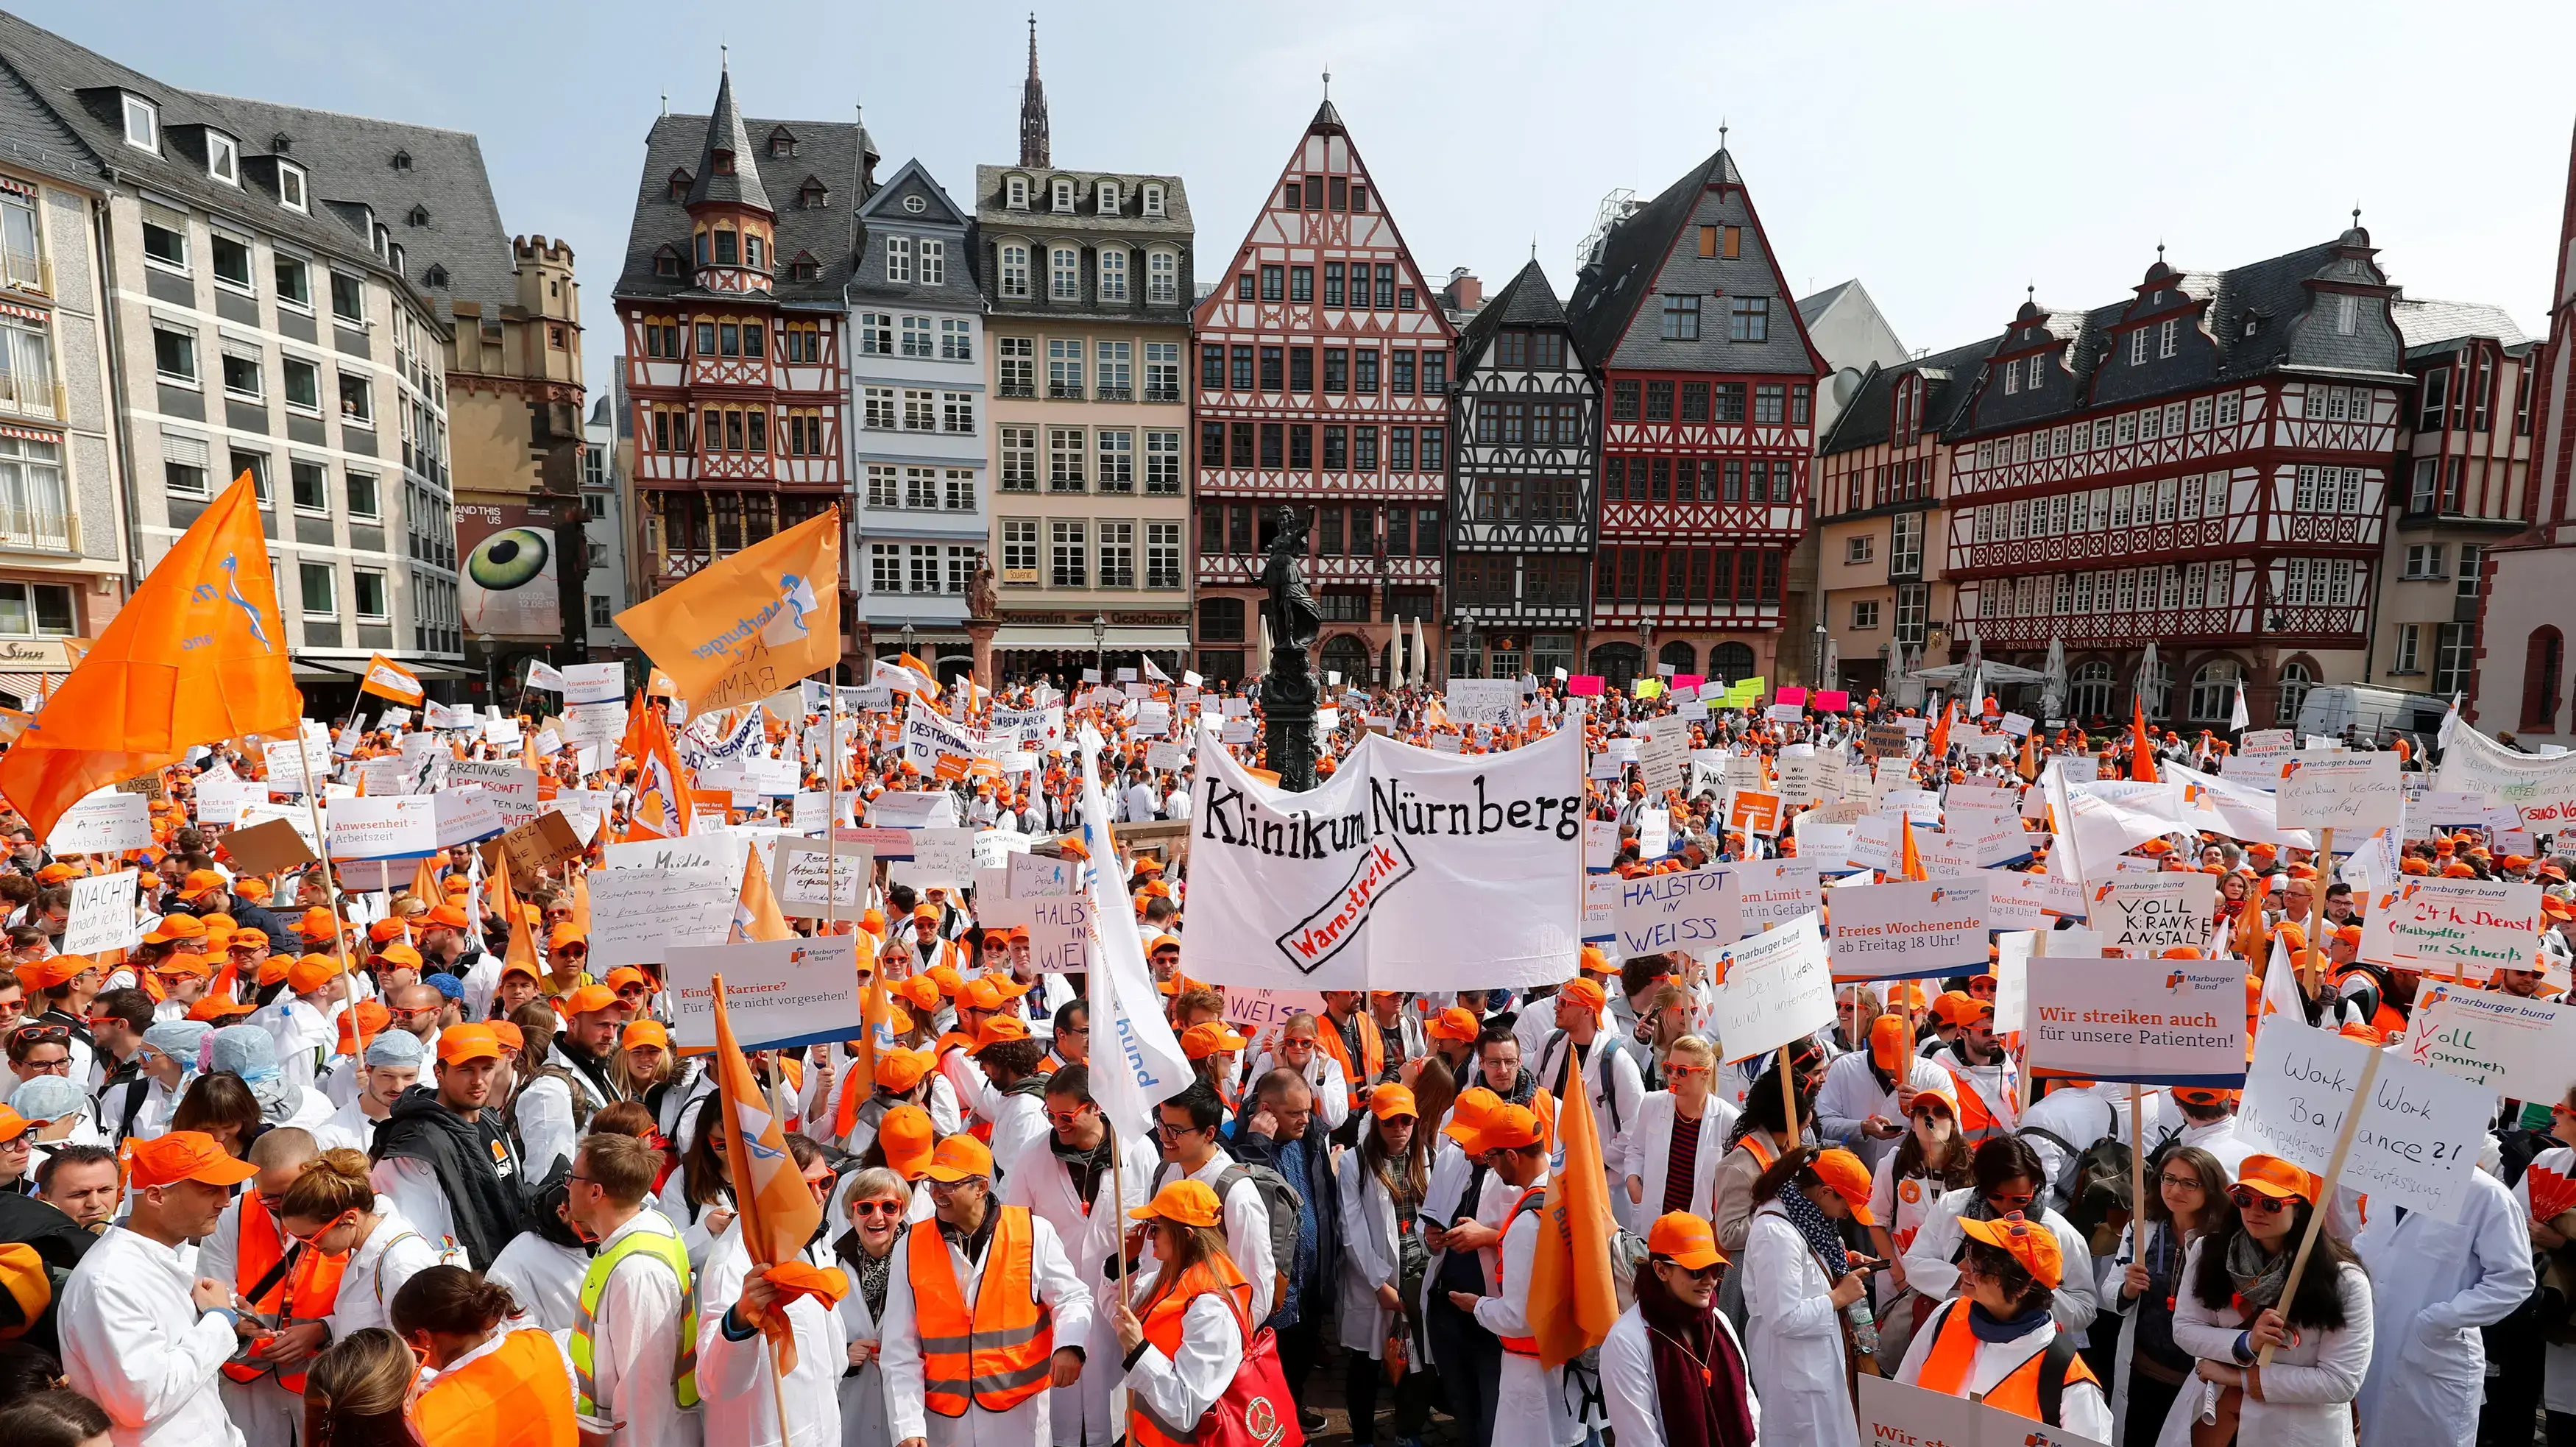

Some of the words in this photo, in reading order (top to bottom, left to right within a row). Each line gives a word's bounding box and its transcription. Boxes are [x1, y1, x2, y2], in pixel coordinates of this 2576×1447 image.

[454, 506, 476, 514] AND
[478, 506, 500, 515] THIS
[487, 516, 501, 524] US
[1002, 612, 1066, 623] Souvenirs
[1111, 612, 1182, 625] Geschenke
[0, 643, 45, 659] Sinn
[567, 679, 609, 687] Anwesenheit
[1457, 693, 1472, 703] WIR
[1476, 693, 1512, 704] LASSEN
[1458, 707, 1479, 719] NICHT
[1022, 715, 1046, 726] ABER
[1869, 737, 1888, 746] MEHR
[2454, 737, 2486, 752] WANN
[911, 743, 928, 757] TO
[1876, 748, 1894, 757] VKA
[2243, 745, 2278, 754] QUALITÄT
[448, 760, 489, 775] ÄRZTIN
[492, 768, 510, 777] AUS
[2501, 768, 2540, 776] STEHT
[127, 777, 160, 791] ARBEITS
[70, 804, 107, 812] marburger
[257, 809, 289, 817] marburger
[516, 802, 533, 811] DAS
[2527, 804, 2558, 820] SIND
[443, 814, 472, 827] streiken
[473, 809, 488, 818] auch
[1202, 776, 1370, 860] Klinikum
[1370, 774, 1582, 842] Nürnberg
[1912, 810, 1936, 818] Gefahr
[334, 818, 408, 832] Anwesenheit
[335, 831, 394, 844] Arbeitszeit
[975, 838, 991, 846] VOM
[974, 848, 990, 857] ZUM
[1933, 854, 1958, 865] Limit
[511, 841, 581, 880] MASCHINE
[590, 874, 612, 885] Wir
[618, 872, 655, 883] streiken
[1622, 871, 1731, 908] HALBTOT
[1945, 888, 1980, 897] Marburger
[2116, 882, 2161, 891] marburger
[2422, 884, 2477, 896] marburger
[2478, 888, 2507, 898] bund
[75, 877, 135, 915] NACHTS
[600, 889, 655, 902] Zeiterfassung
[1290, 843, 1399, 960] Warnstreik
[1741, 892, 1762, 904] am
[1764, 889, 1802, 902] Limit
[646, 902, 699, 913] Wochenenden
[1663, 900, 1680, 913] IN
[1757, 905, 1769, 917] in
[1773, 903, 1816, 916] Gefahr
[2017, 908, 2037, 917] Uhr!
[69, 914, 96, 933] mach
[2415, 902, 2467, 924] 24-h
[2469, 910, 2535, 931] Dienst
[1072, 927, 1086, 939] IN
[1837, 924, 1882, 938] Freies
[1885, 916, 1981, 935] Wochenende
[1625, 917, 1718, 952] WEISS
[1736, 939, 1780, 963] marburger
[1783, 930, 1800, 946] bund
[1838, 940, 1854, 953] ab
[1858, 937, 1906, 953] Freitag
[1911, 937, 1925, 949] 18
[1929, 933, 1960, 947] Uhr!
[807, 947, 847, 957] Marburger
[2445, 942, 2522, 964] Schweiß
[1781, 961, 1814, 986] Mudda
[2187, 974, 2234, 984] Marburger
[680, 988, 712, 999] Kind
[726, 981, 787, 994] Karriere?
[2194, 983, 2218, 991] Bund
[682, 1002, 705, 1014] Für
[707, 997, 740, 1011] Äzte
[744, 996, 774, 1009] nicht
[777, 989, 849, 1005] vorgesehen!
[2450, 995, 2519, 1013] marburger
[2520, 1008, 2556, 1020] bund
[1730, 1006, 1762, 1030] wird
[2038, 1006, 2077, 1022] Wir
[2084, 1009, 2163, 1025] streiken
[2169, 1012, 2218, 1027] auch
[2039, 1026, 2065, 1041] für
[2071, 1029, 2133, 1044] unsere
[2139, 1030, 2234, 1049] Patienten!
[1116, 1017, 1160, 1089] bund
[2285, 1052, 2354, 1092] Work-
[2377, 1079, 2431, 1119] Work
[2240, 1105, 2331, 1158] Manipulations-
[1872, 1422, 1917, 1446] Wir
